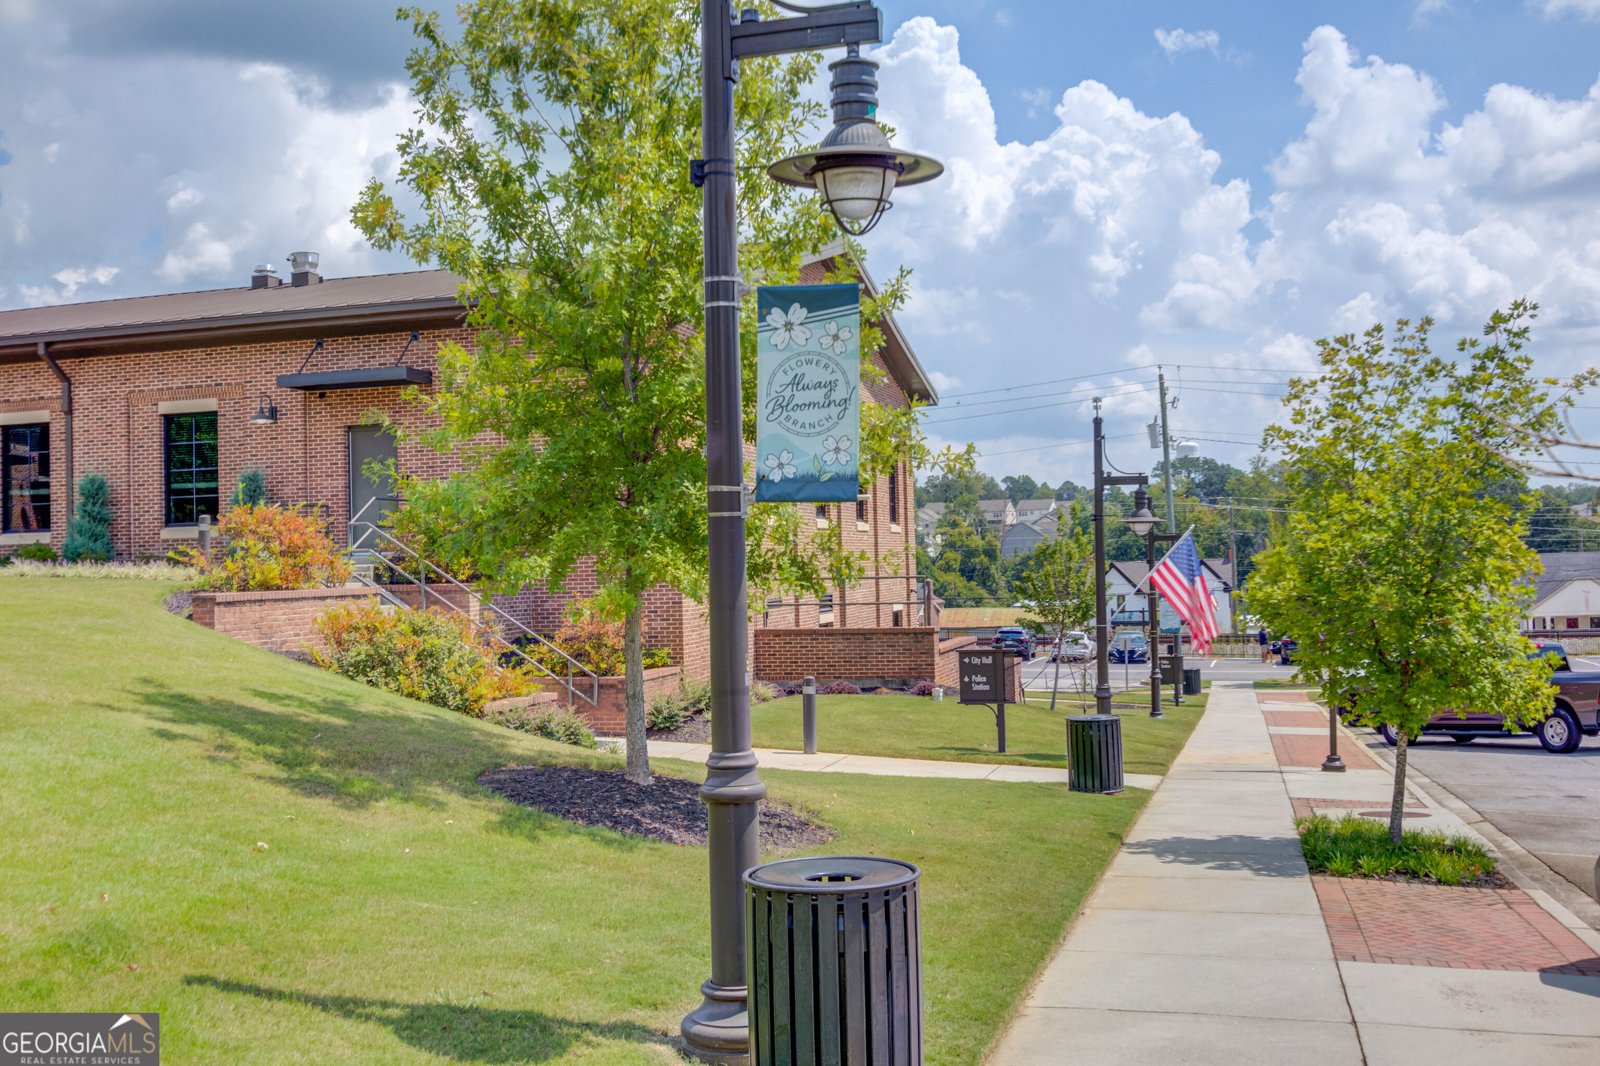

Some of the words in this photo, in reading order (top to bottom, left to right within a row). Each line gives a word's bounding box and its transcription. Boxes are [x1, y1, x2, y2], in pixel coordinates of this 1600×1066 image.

[782, 358, 837, 376] FLOWERY
[775, 373, 838, 399] Always
[765, 386, 855, 422] Blooming!
[784, 414, 833, 430] BRANCH
[971, 656, 981, 665] City
[981, 656, 992, 664] Hall
[971, 674, 987, 682] Police
